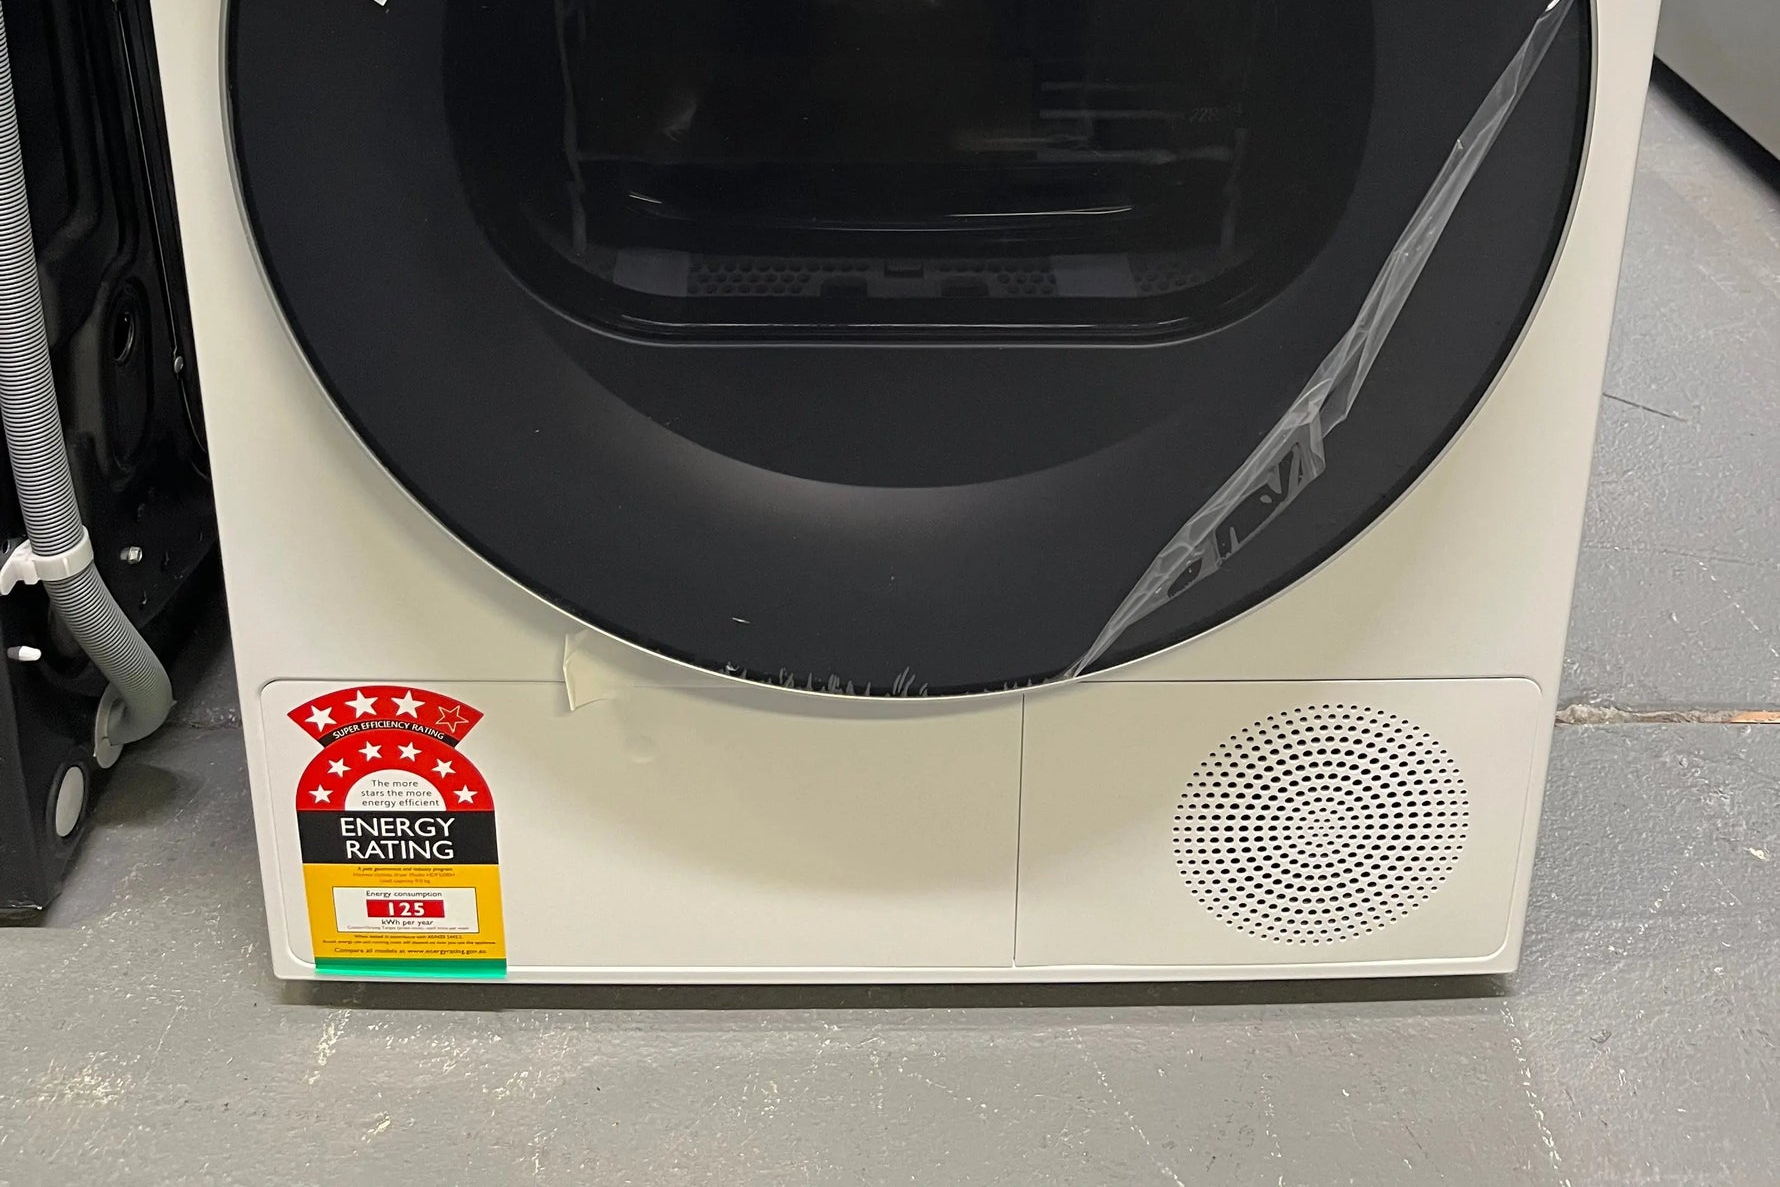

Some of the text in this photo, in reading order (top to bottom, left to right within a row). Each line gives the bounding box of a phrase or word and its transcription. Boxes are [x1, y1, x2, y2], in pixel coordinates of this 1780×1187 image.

[332, 721, 444, 740] SUPER EFFICIENCY RATING
[371, 780, 389, 788] The
[387, 789, 403, 797] the
[362, 799, 439, 808] energy efficient
[340, 817, 456, 837] ENERGY
[345, 840, 454, 860] RATING
[366, 890, 442, 898] Energy consumption
[388, 902, 425, 916] 125
